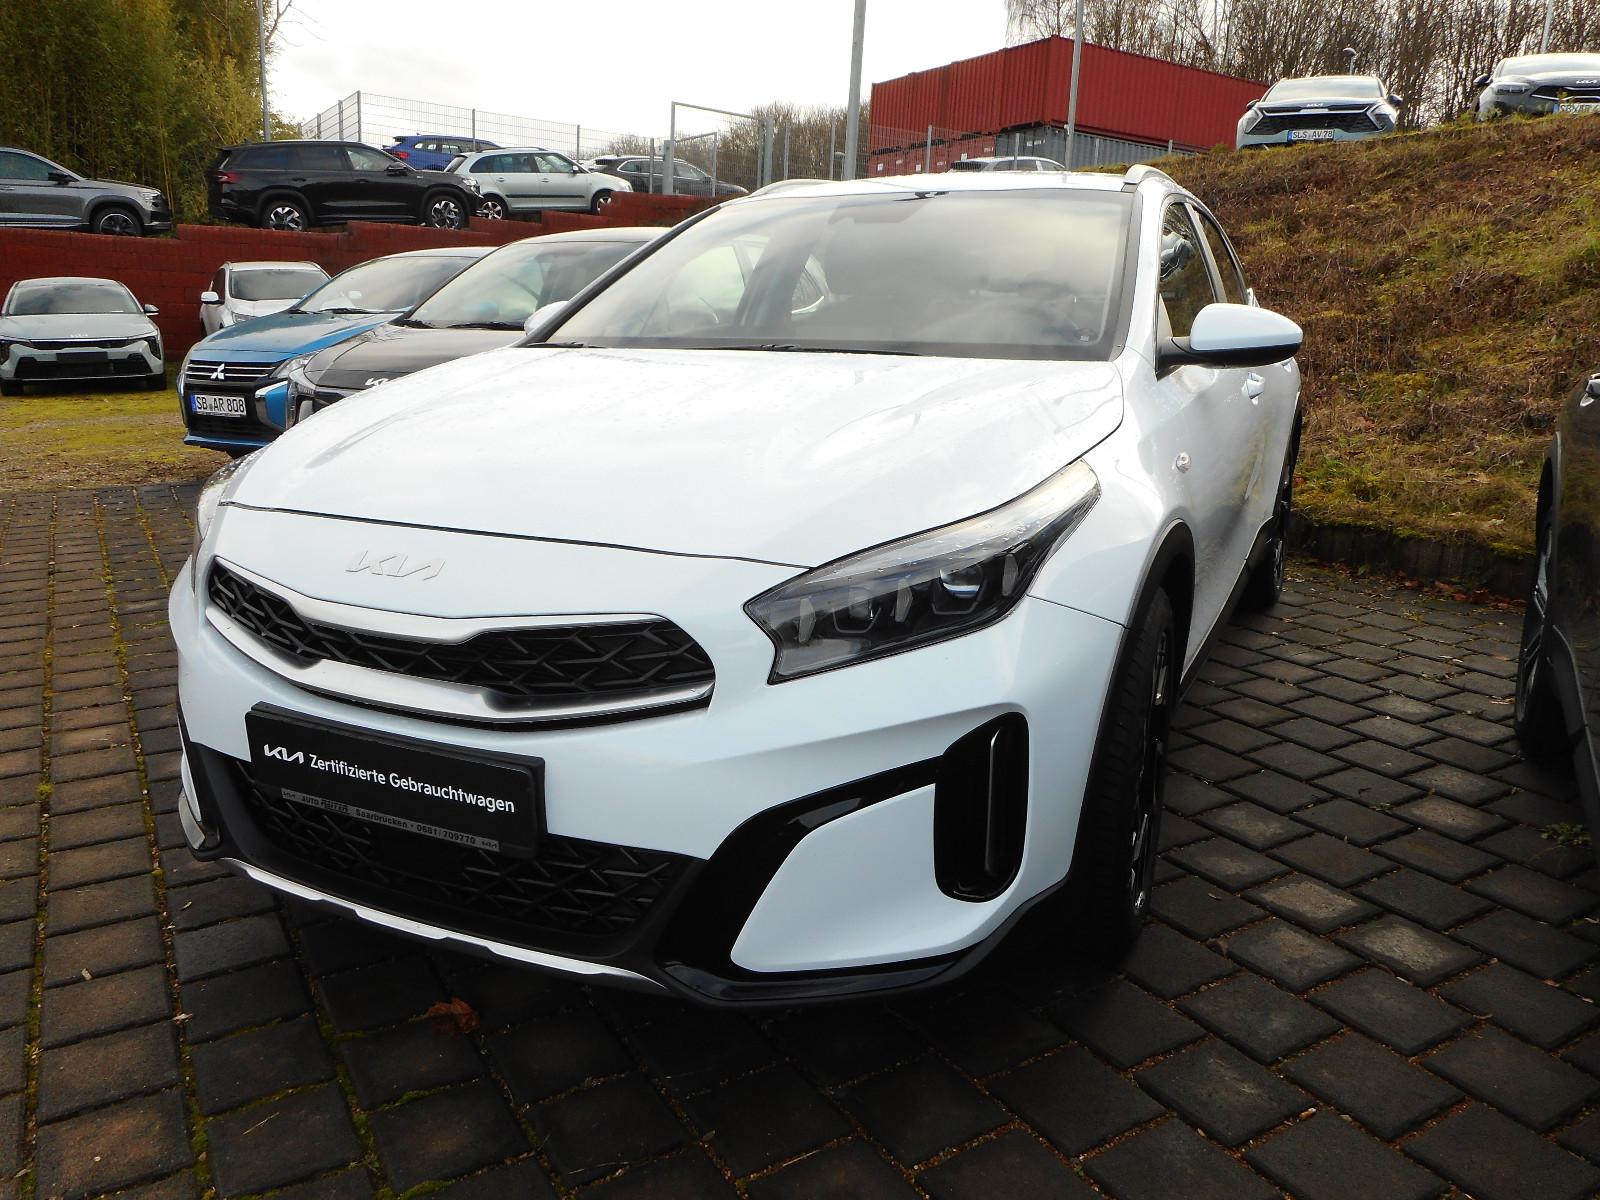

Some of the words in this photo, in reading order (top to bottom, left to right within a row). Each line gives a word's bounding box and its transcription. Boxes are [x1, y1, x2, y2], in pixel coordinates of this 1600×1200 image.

[1292, 131, 1308, 139] SLS
[1311, 130, 1323, 138] AV
[196, 396, 208, 410] SB
[213, 397, 226, 412] AR
[227, 398, 245, 413] 808
[263, 743, 305, 765] KIA
[308, 753, 387, 785] Zertifizierte
[389, 773, 515, 813] Gebrauchtwagen
